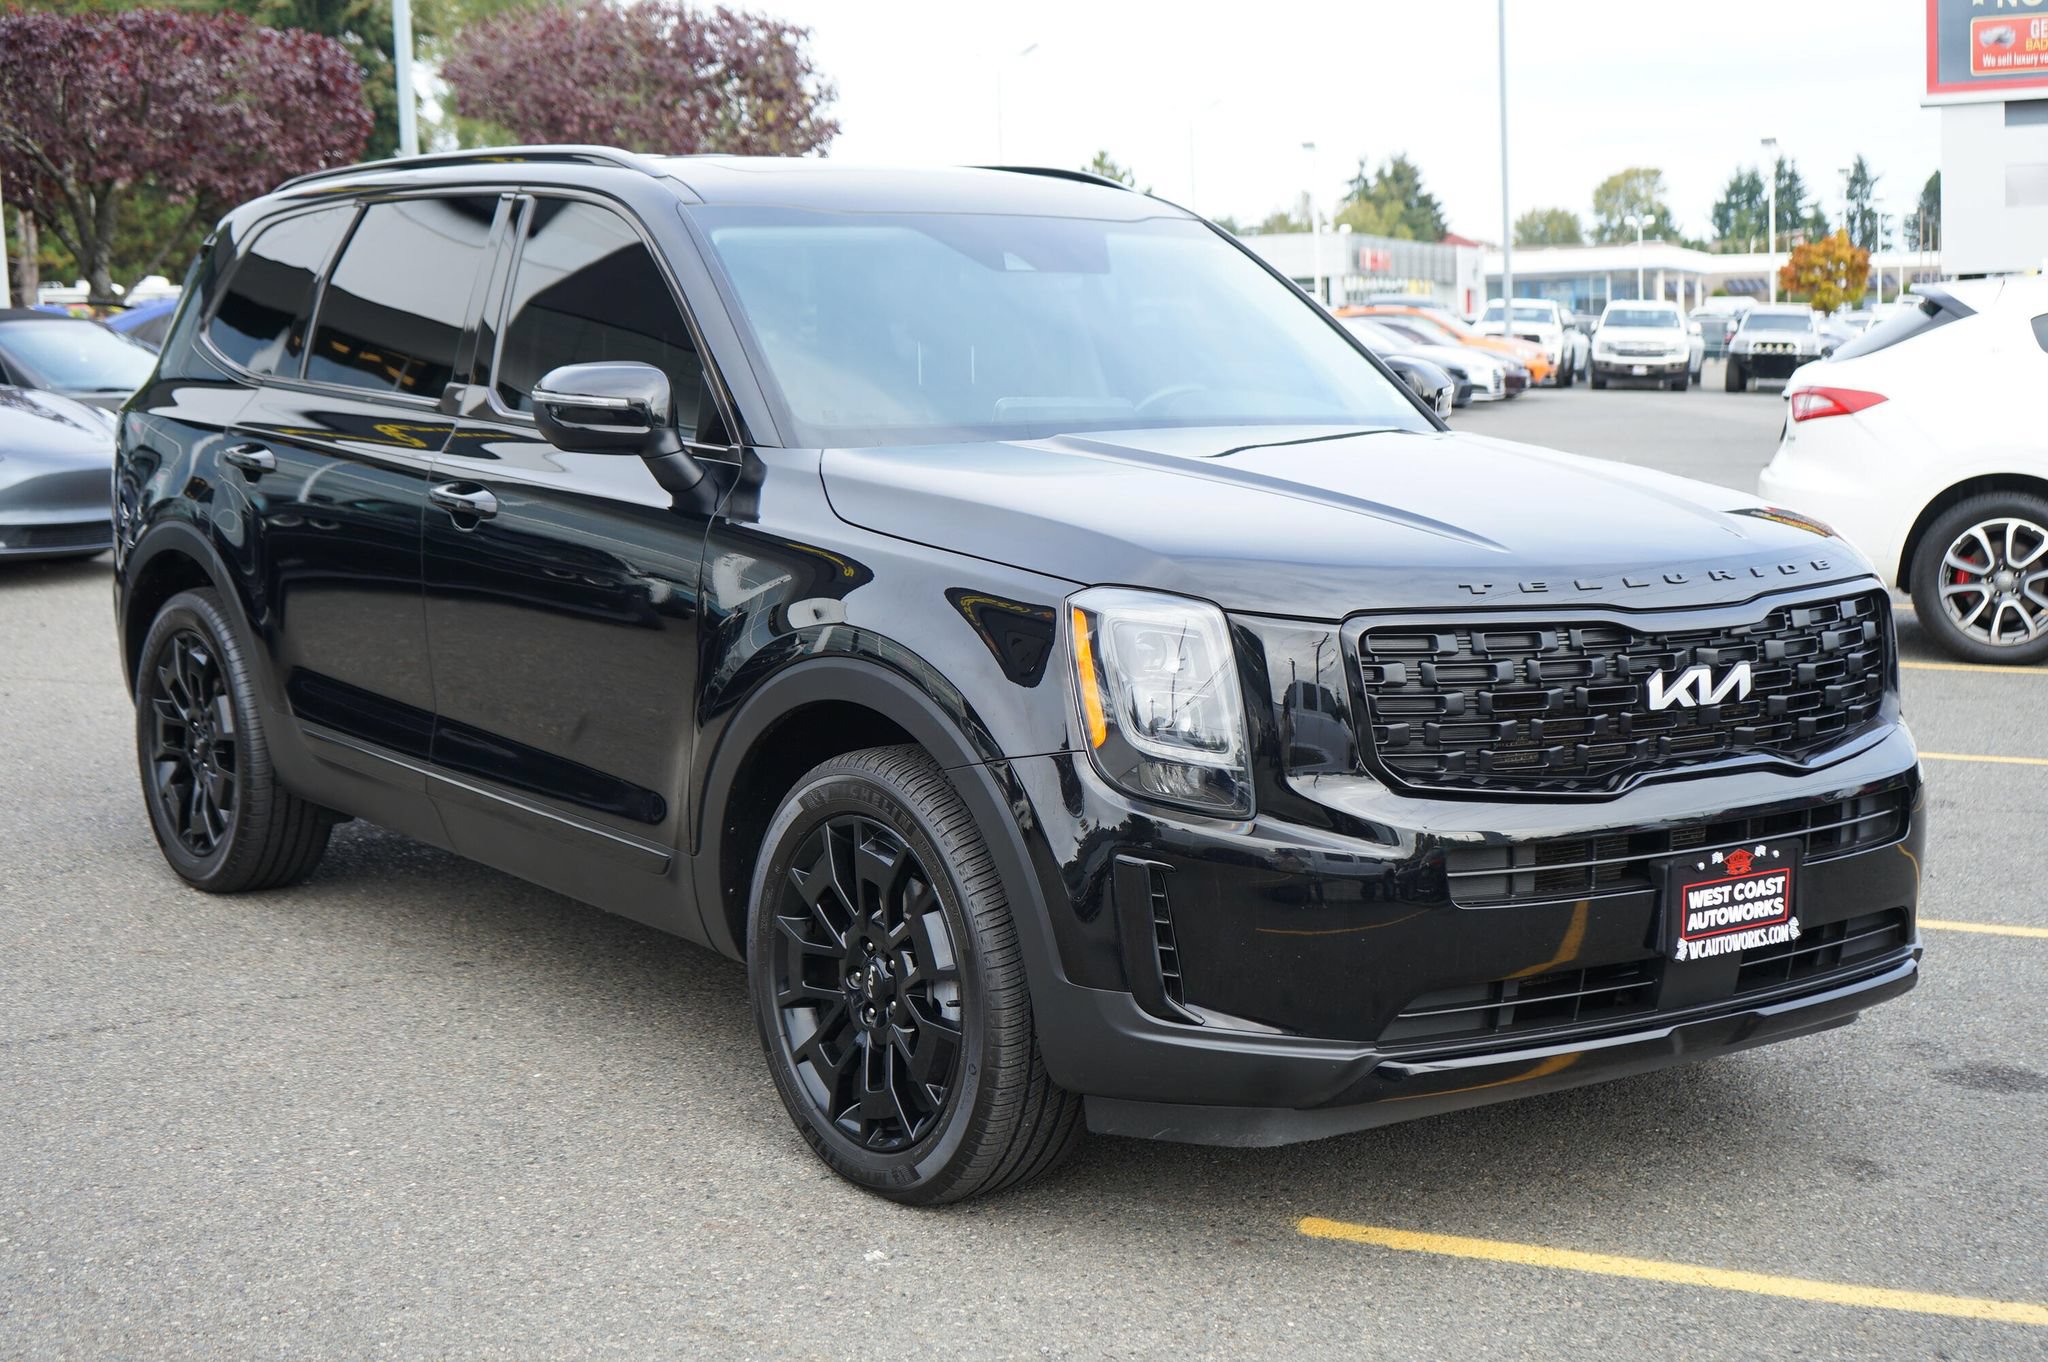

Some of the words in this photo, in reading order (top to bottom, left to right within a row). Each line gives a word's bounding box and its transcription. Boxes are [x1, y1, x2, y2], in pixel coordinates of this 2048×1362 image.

[1983, 53, 1996, 67] We
[1997, 51, 2012, 66] sell
[2013, 51, 2039, 66] luxury
[1458, 559, 1832, 595] TELLURIDE
[1648, 660, 1752, 711] KIA
[1688, 885, 1732, 909] WEST
[1733, 876, 1785, 901] COAST
[1687, 897, 1784, 931] AUTOWORKS
[1688, 924, 1790, 960] WCAUTOWORKS.COM
